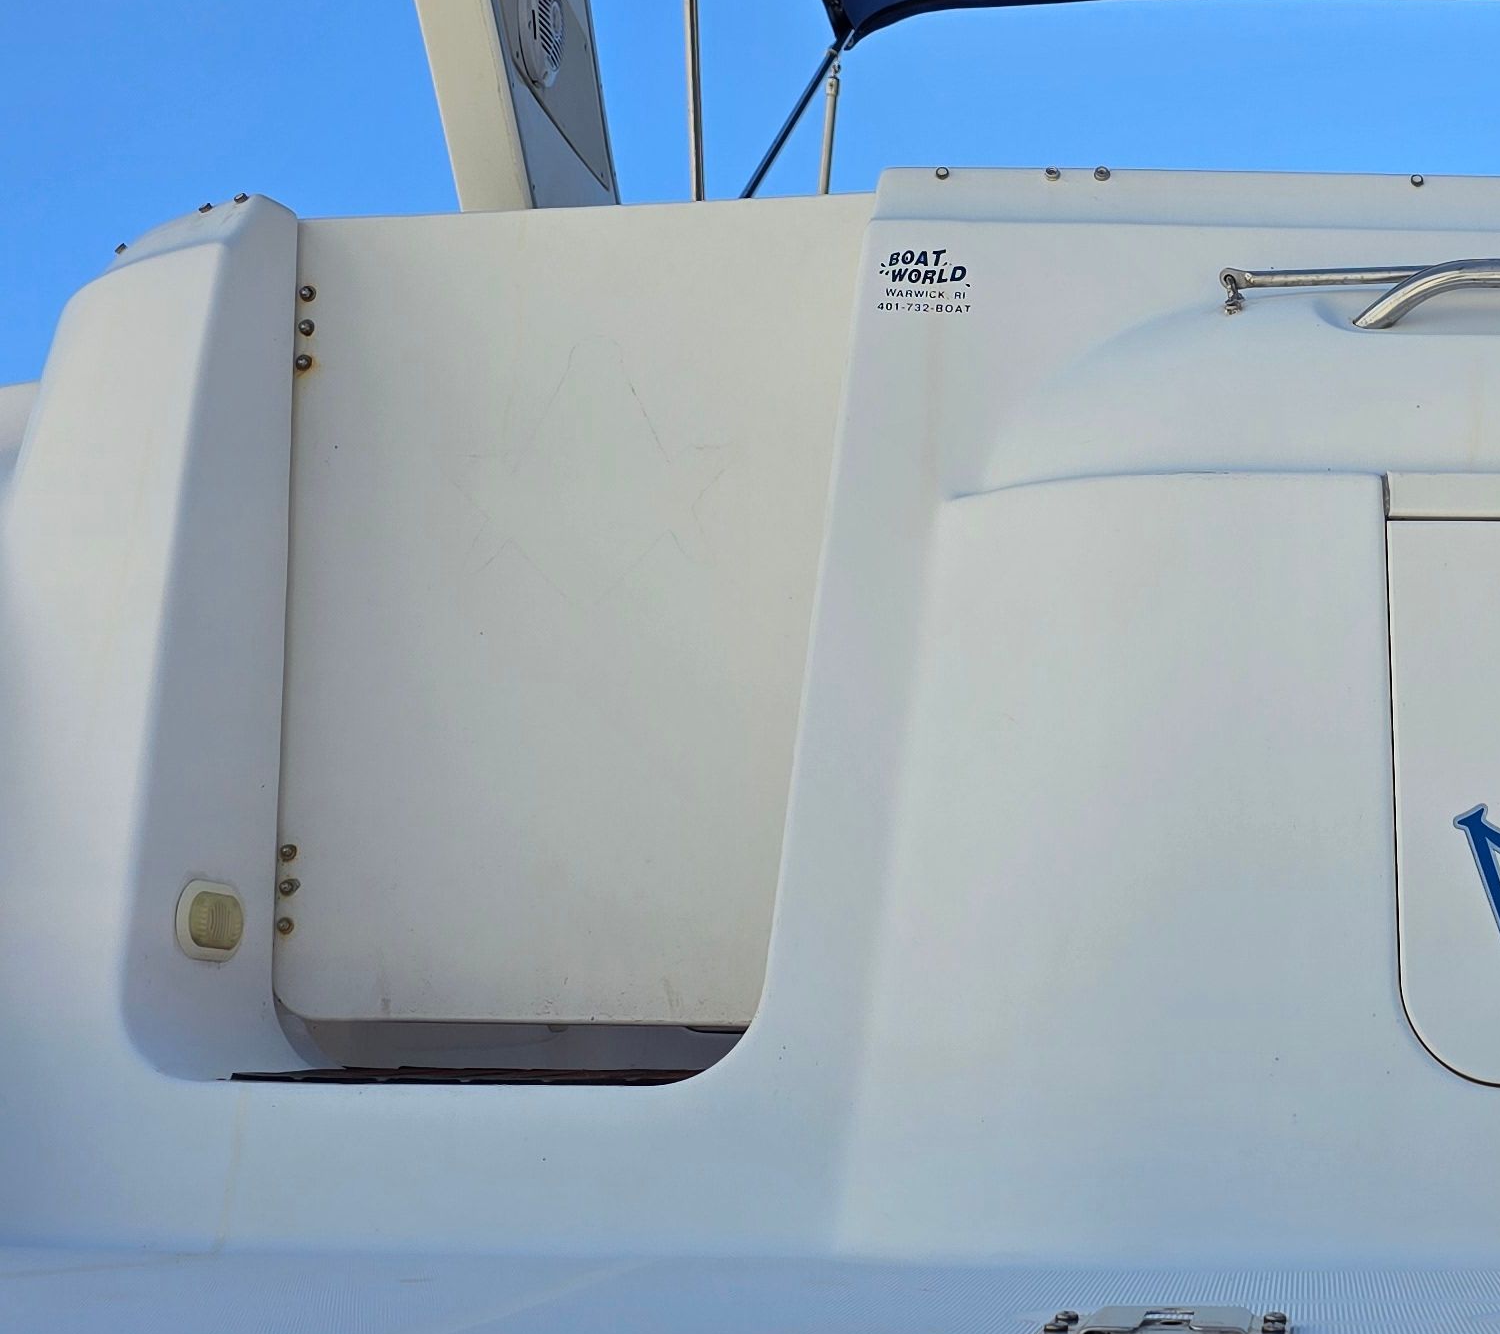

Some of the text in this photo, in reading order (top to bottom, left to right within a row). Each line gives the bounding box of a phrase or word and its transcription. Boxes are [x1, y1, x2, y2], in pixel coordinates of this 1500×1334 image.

[889, 249, 946, 267] BOAT
[891, 266, 967, 285] WORLD
[954, 291, 966, 299] RI
[877, 302, 971, 313] 401-732-BOAT
